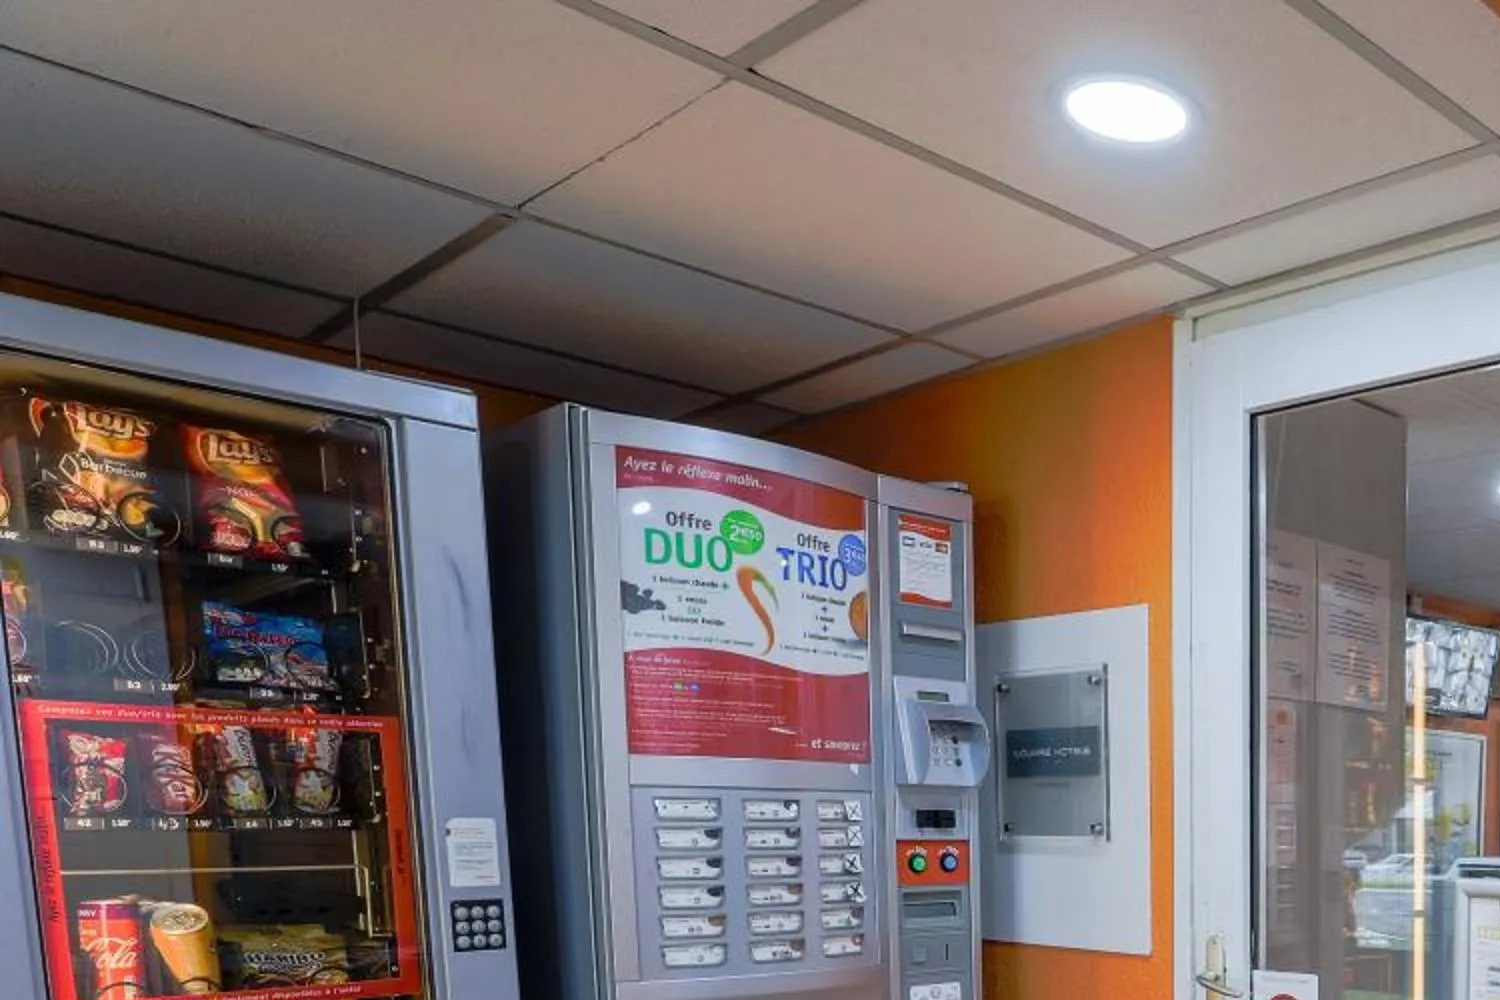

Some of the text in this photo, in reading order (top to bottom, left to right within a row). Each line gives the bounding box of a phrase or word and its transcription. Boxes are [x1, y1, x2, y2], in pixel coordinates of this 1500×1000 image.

[623, 455, 658, 472] Ayez
[660, 460, 673, 473] le
[665, 511, 713, 531] Offre
[643, 526, 734, 573] DUO
[796, 533, 831, 553] Offre
[775, 547, 848, 592] TRIO
